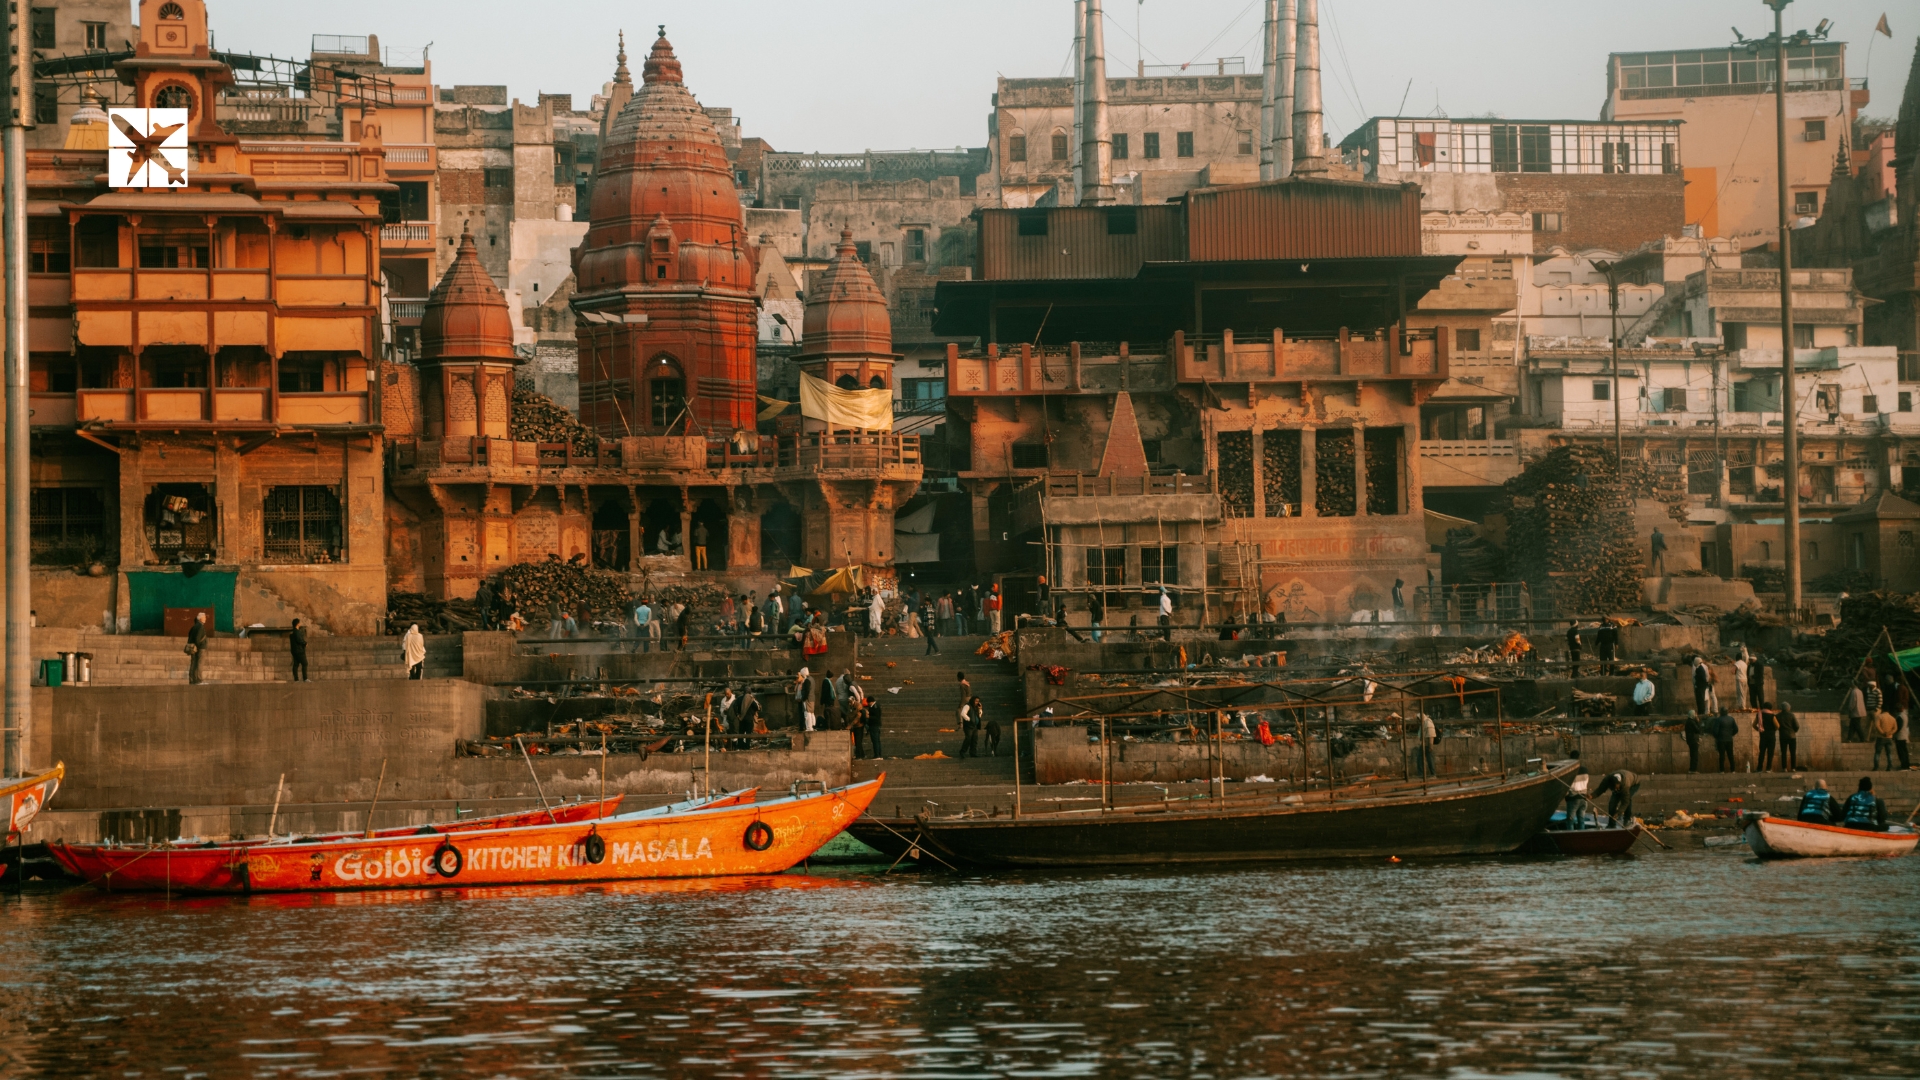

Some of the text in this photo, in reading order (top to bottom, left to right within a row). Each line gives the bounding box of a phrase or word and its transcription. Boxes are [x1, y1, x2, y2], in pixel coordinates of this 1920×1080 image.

[312, 728, 432, 742] Manikarnika Ghat
[831, 802, 845, 820] 92
[467, 845, 553, 871] KITCHEN
[557, 843, 606, 868] KIN
[611, 837, 713, 865] MASALA
